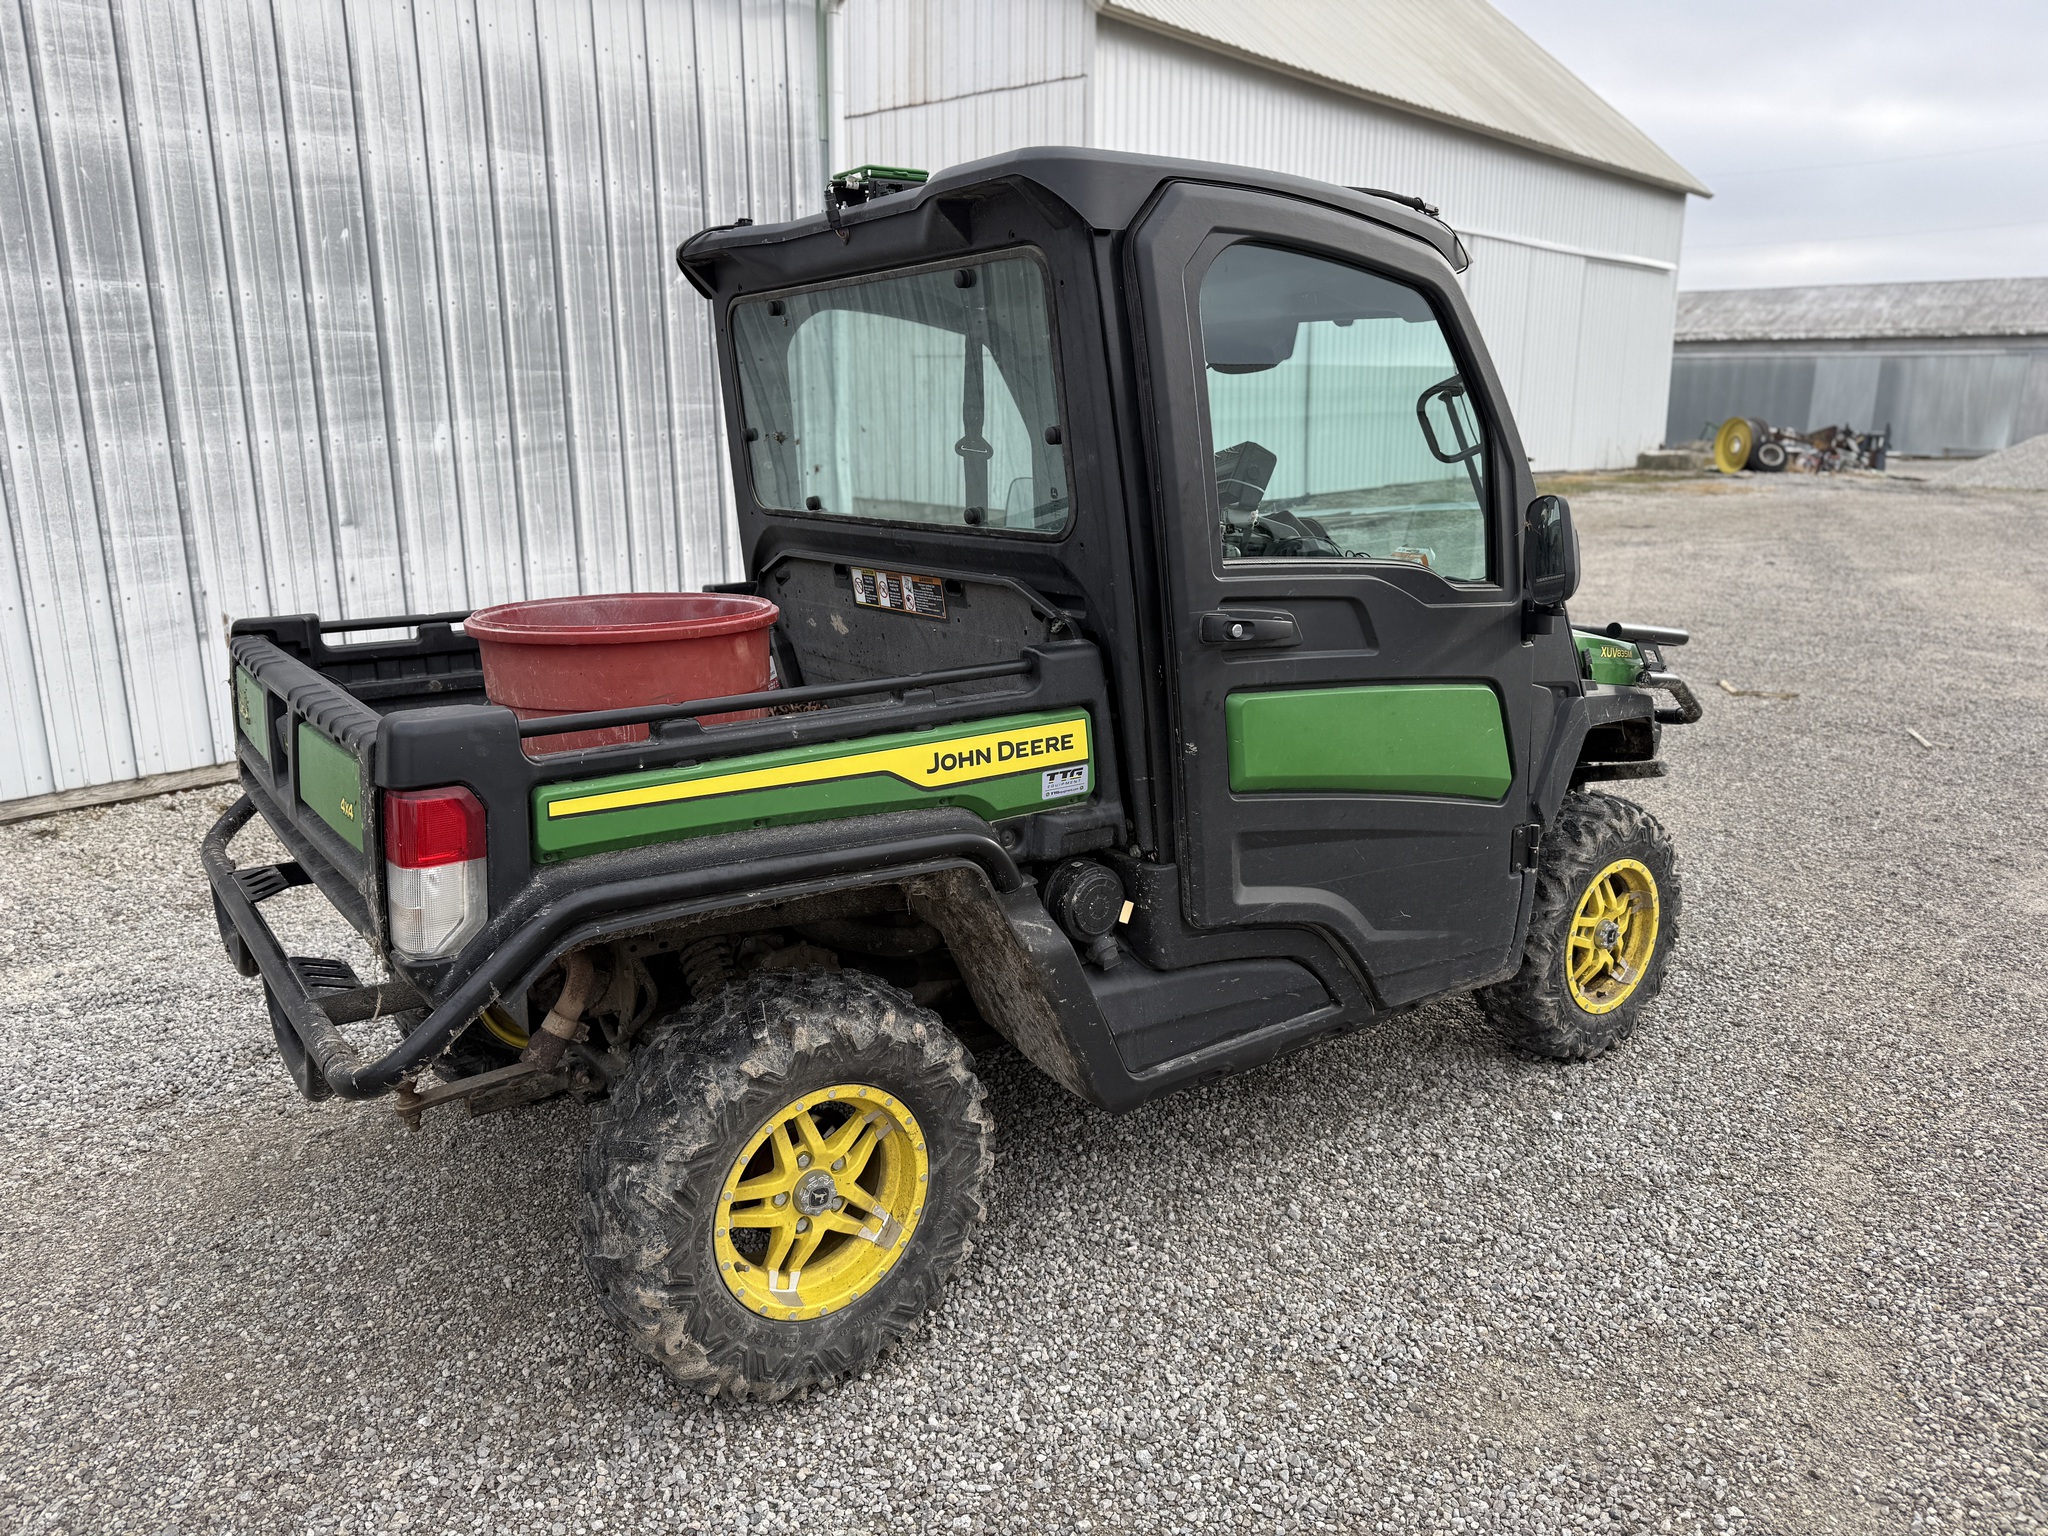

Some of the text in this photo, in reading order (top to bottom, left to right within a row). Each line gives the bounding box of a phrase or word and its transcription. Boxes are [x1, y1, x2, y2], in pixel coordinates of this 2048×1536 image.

[926, 733, 1074, 775] JOHN DEERE
[1046, 767, 1084, 784] TTG
[1047, 779, 1082, 789] EQUIPMENT
